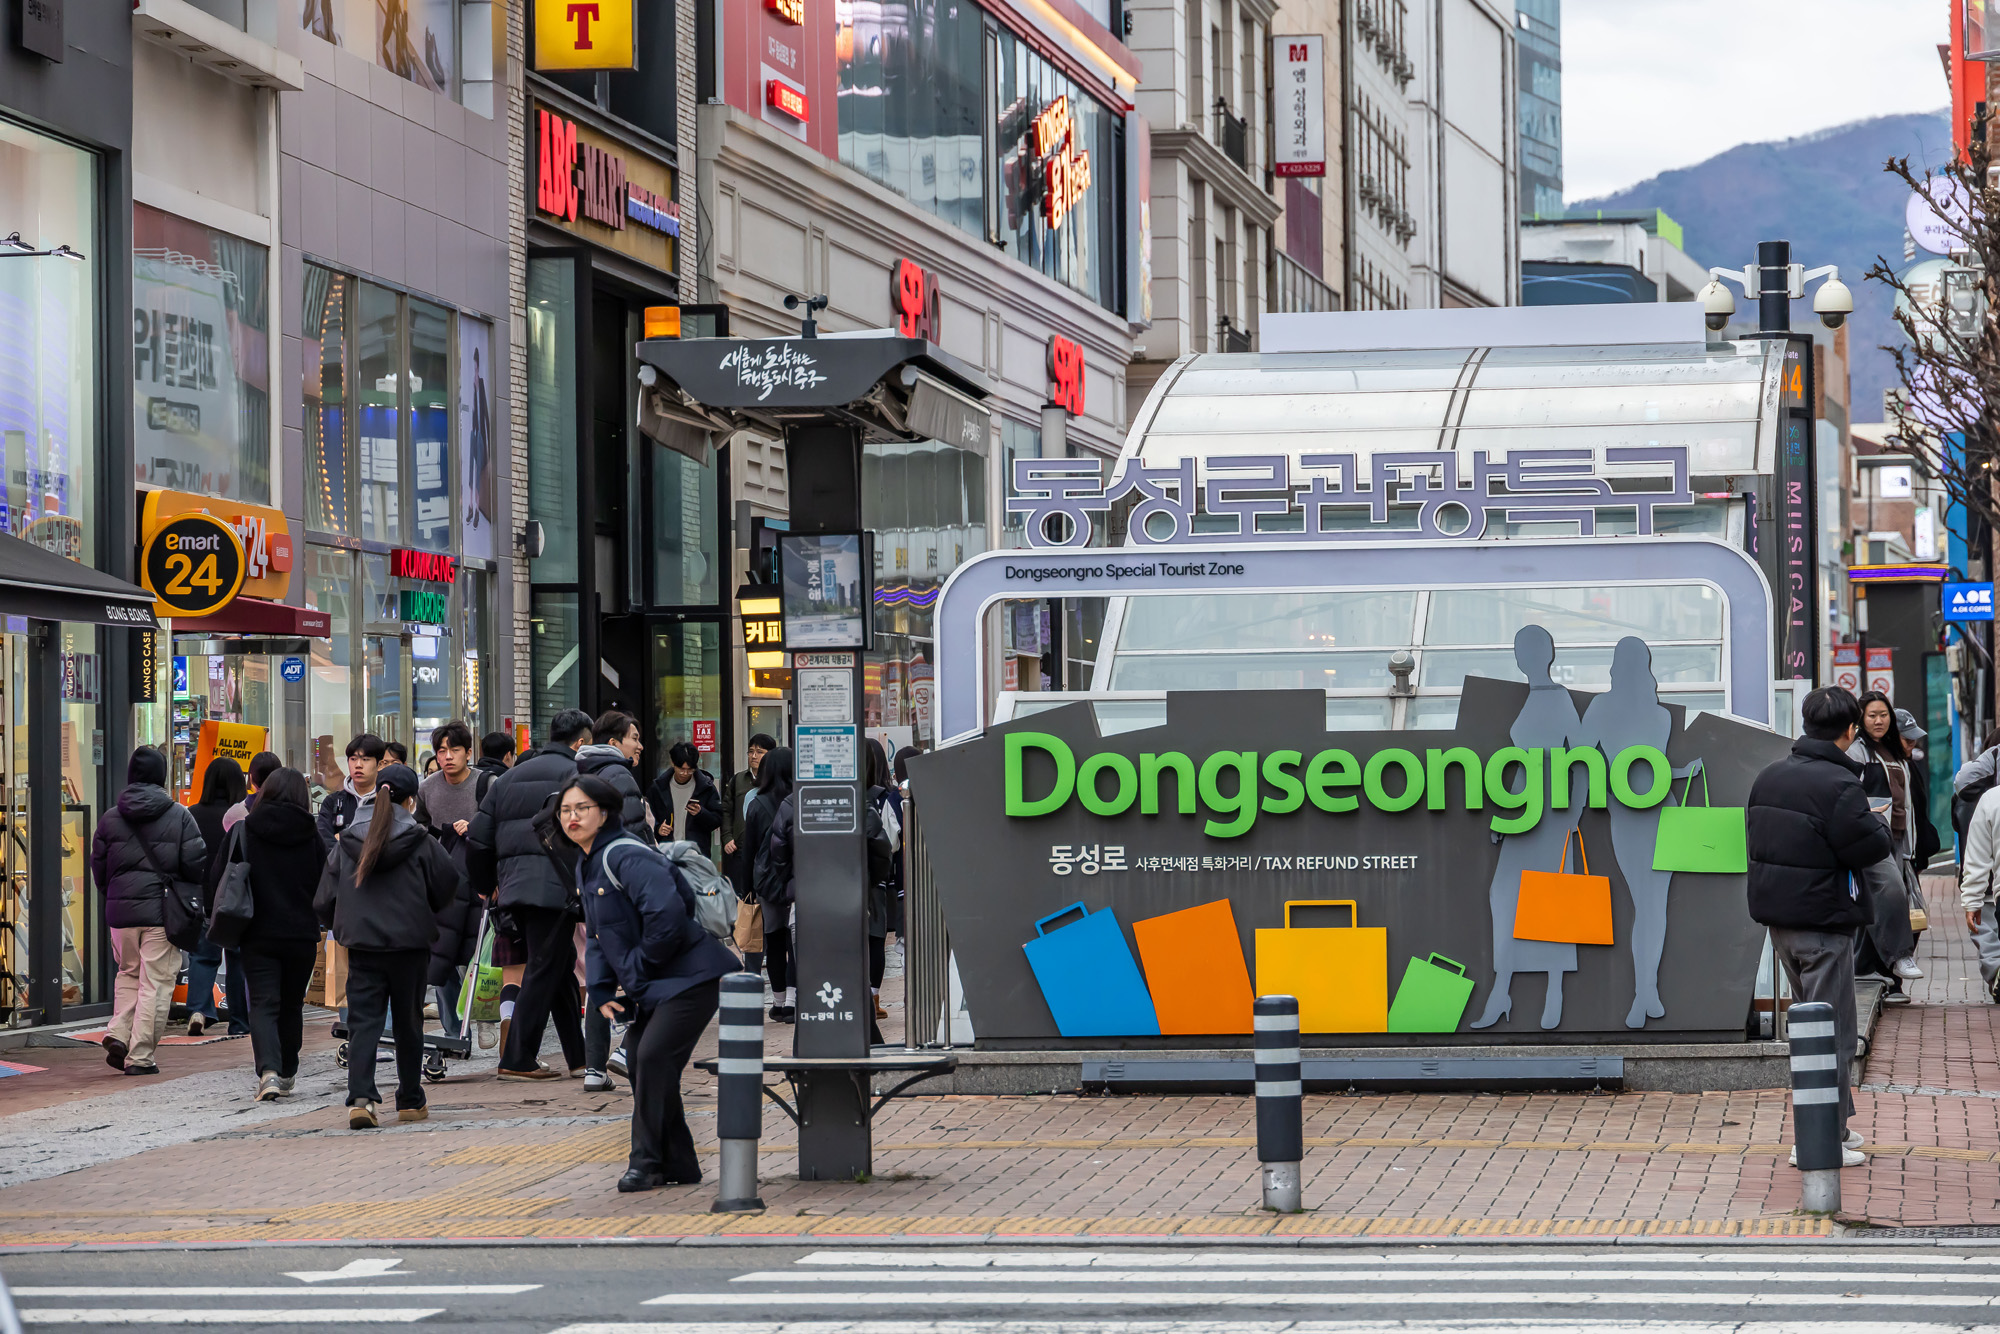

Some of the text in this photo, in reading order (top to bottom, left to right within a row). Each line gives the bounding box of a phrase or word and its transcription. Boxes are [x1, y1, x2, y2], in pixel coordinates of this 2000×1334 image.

[538, 109, 627, 231] ABC-MART
[900, 257, 941, 347] SPAO
[1053, 333, 1086, 416] SPAO
[165, 533, 220, 550] emart
[165, 553, 223, 596] 24
[401, 549, 455, 584] KUMKANG
[1005, 562, 1244, 582] Dongseongno Special Tourist Zone
[105, 605, 152, 622] BONG BONG
[745, 620, 782, 643] 커피
[143, 631, 151, 699] MANGO CASE
[284, 664, 302, 675] ADT
[212, 747, 252, 760] HGHLIGHT
[219, 738, 248, 749] ALL DAY
[1004, 731, 1671, 839] Dongseongno
[1049, 844, 1129, 876] 동성로
[1135, 856, 1199, 872] 사후면세점
[1201, 856, 1252, 872] 특화거리
[1263, 856, 1292, 870] TAX
[1297, 856, 1358, 870] REFUND
[1362, 856, 1418, 870] STREET
